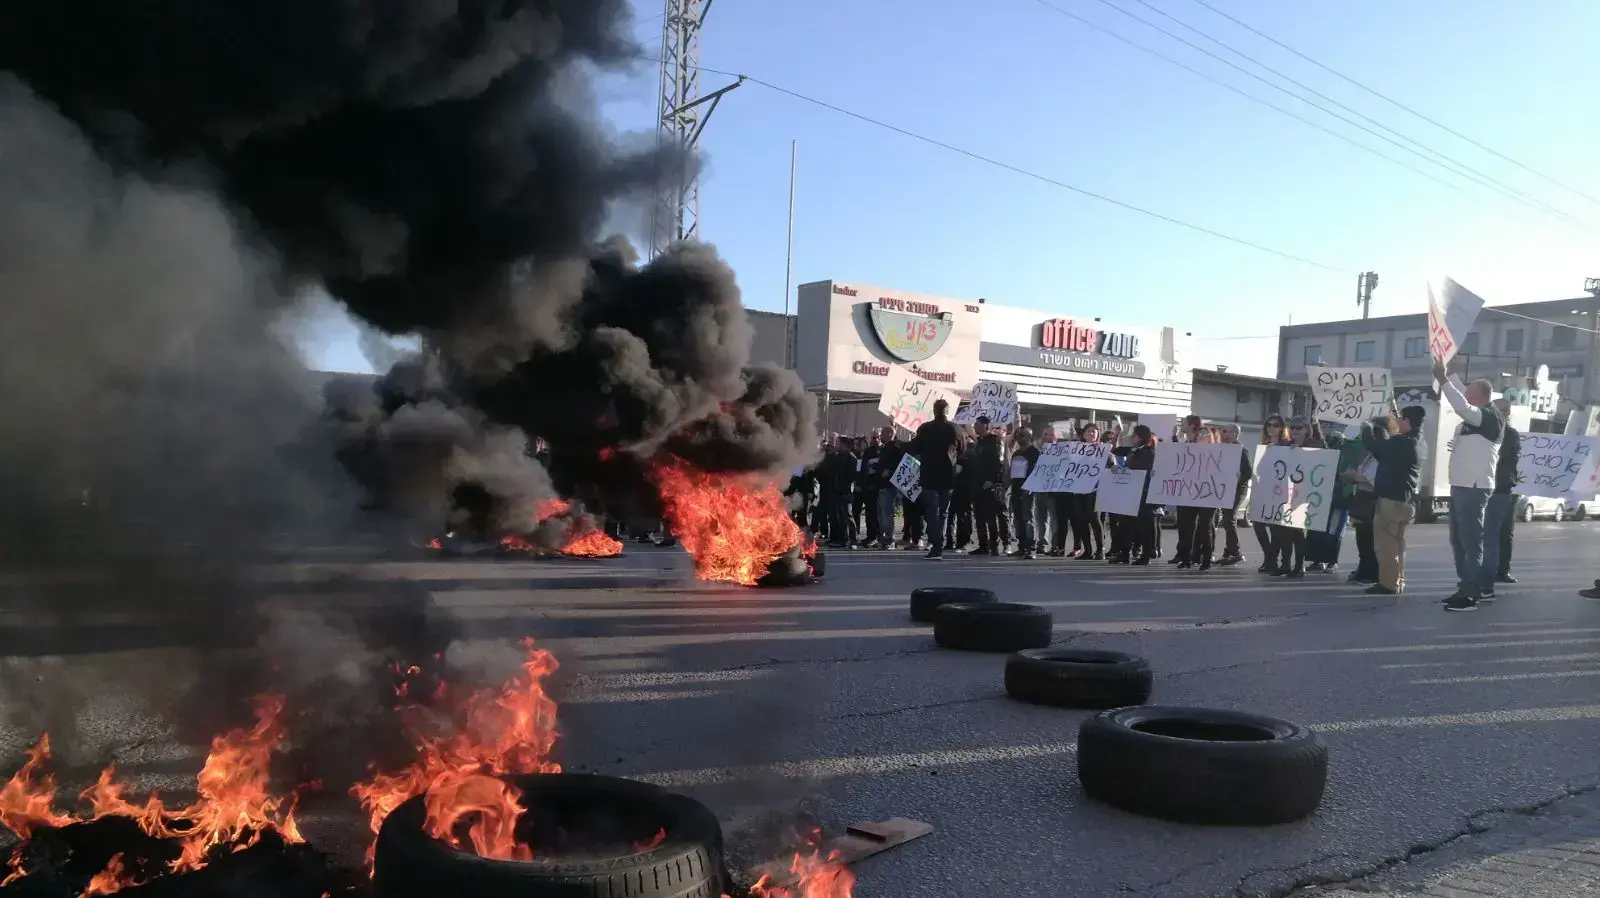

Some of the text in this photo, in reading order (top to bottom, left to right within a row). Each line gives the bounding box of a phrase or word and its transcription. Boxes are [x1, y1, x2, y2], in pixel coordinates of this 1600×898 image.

[1042, 318, 1141, 359] office zone
[852, 360, 957, 383] Chines taurant
[1039, 352, 1135, 374] תעשיות ריהוט משרדי
[1065, 462, 1100, 479] זקוק
